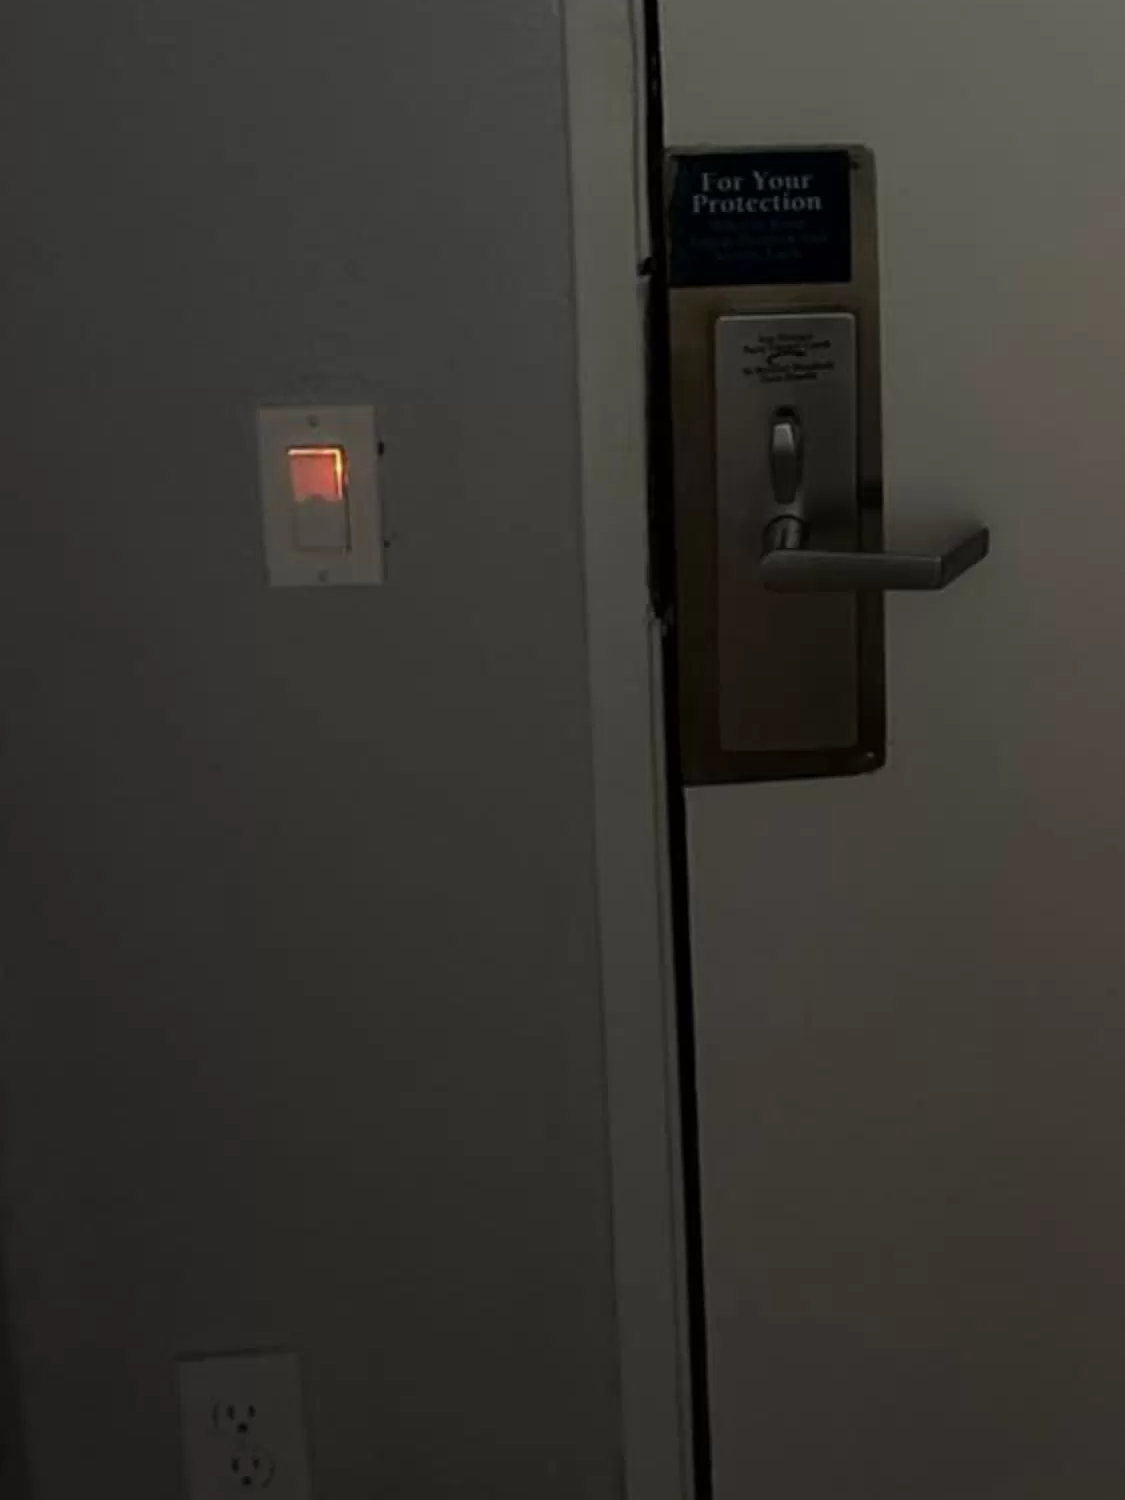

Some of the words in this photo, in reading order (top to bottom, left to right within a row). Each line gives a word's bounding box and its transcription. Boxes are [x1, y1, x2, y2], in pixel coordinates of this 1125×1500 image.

[701, 171, 745, 192] For
[752, 168, 815, 191] Your
[692, 192, 823, 215] Protection
